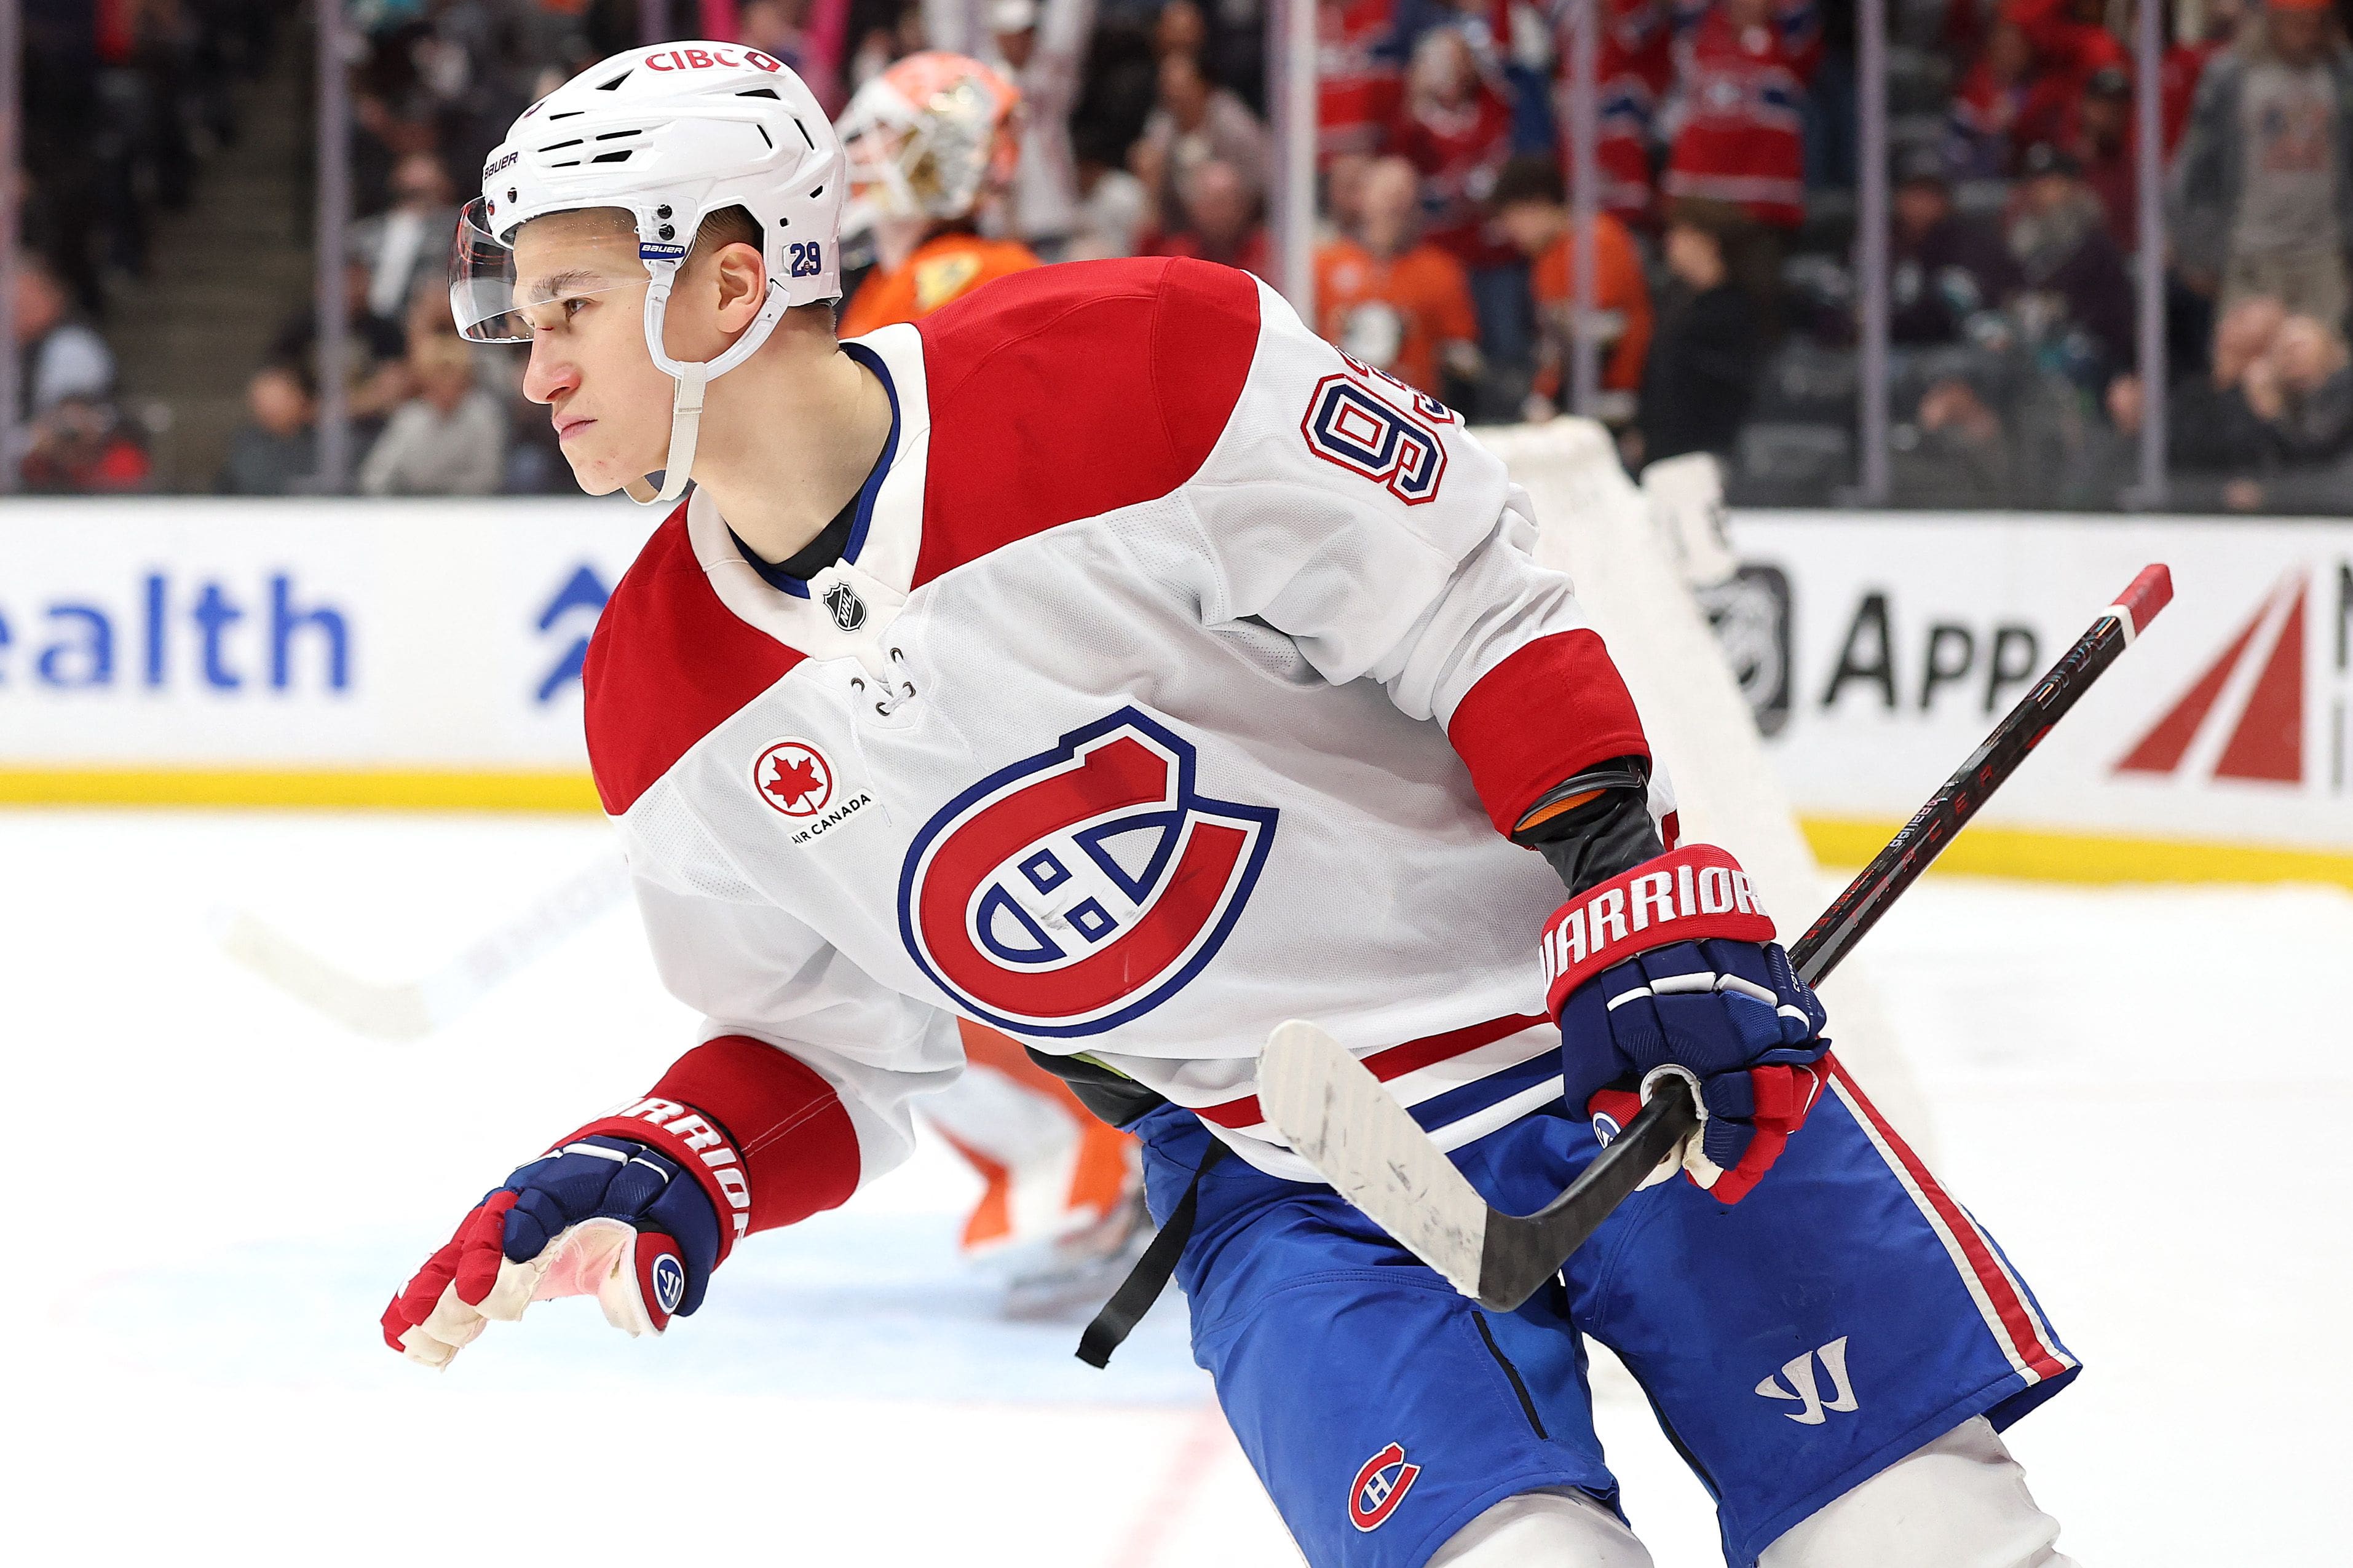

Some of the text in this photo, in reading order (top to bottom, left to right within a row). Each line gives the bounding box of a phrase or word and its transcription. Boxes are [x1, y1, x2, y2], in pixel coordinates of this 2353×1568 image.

[645, 49, 741, 71] CIBC
[641, 244, 684, 254] BAUER
[790, 241, 822, 278] 29
[0, 574, 347, 688] alth
[791, 794, 871, 845] AIR CANADA
